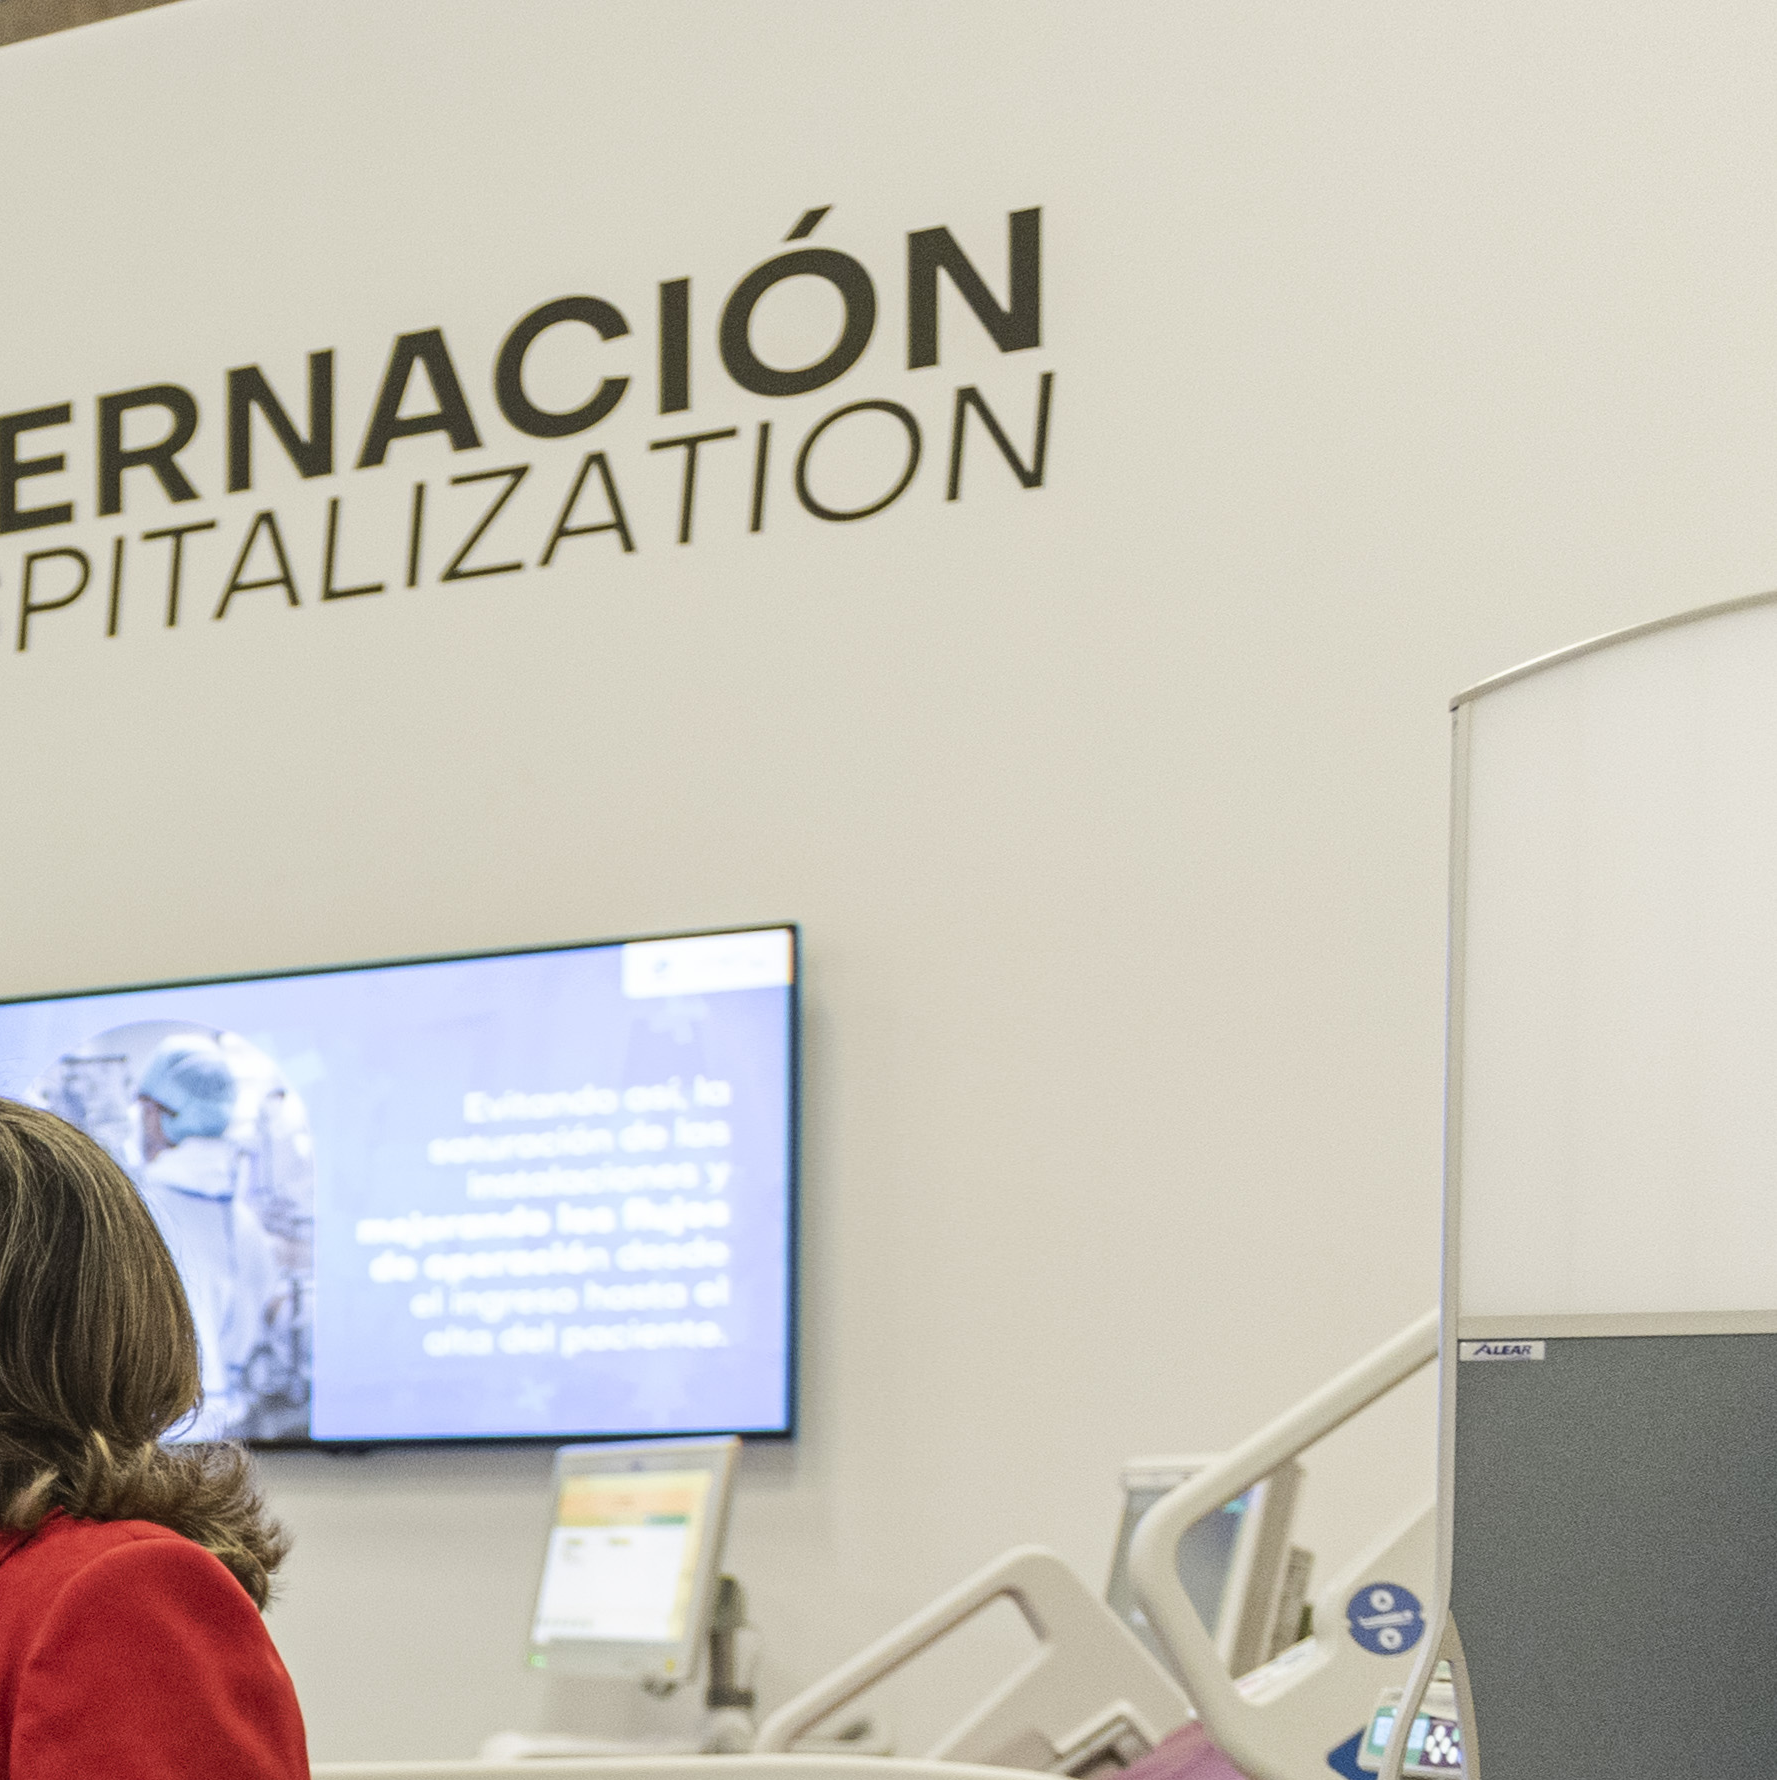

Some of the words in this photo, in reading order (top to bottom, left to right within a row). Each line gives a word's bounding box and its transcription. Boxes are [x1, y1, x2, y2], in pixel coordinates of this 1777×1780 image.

[463, 1083, 618, 1123] Evitando
[694, 1074, 731, 1107] la
[428, 1122, 614, 1165] saturación
[618, 1118, 668, 1153] de
[467, 1161, 699, 1200] instalaciones
[705, 1161, 731, 1194] y
[356, 1204, 551, 1250] mejorando
[621, 1196, 730, 1237] flujos
[369, 1250, 418, 1283] de
[423, 1240, 610, 1286] operación
[615, 1236, 730, 1272] desde
[409, 1286, 444, 1319] el
[448, 1286, 579, 1323] ingreso
[583, 1279, 688, 1311] hasta
[693, 1274, 730, 1308] el
[422, 1324, 494, 1357] alta
[498, 1320, 555, 1354] del
[560, 1318, 729, 1359] paciente.
[1473, 1344, 1532, 1356] ALEAR
